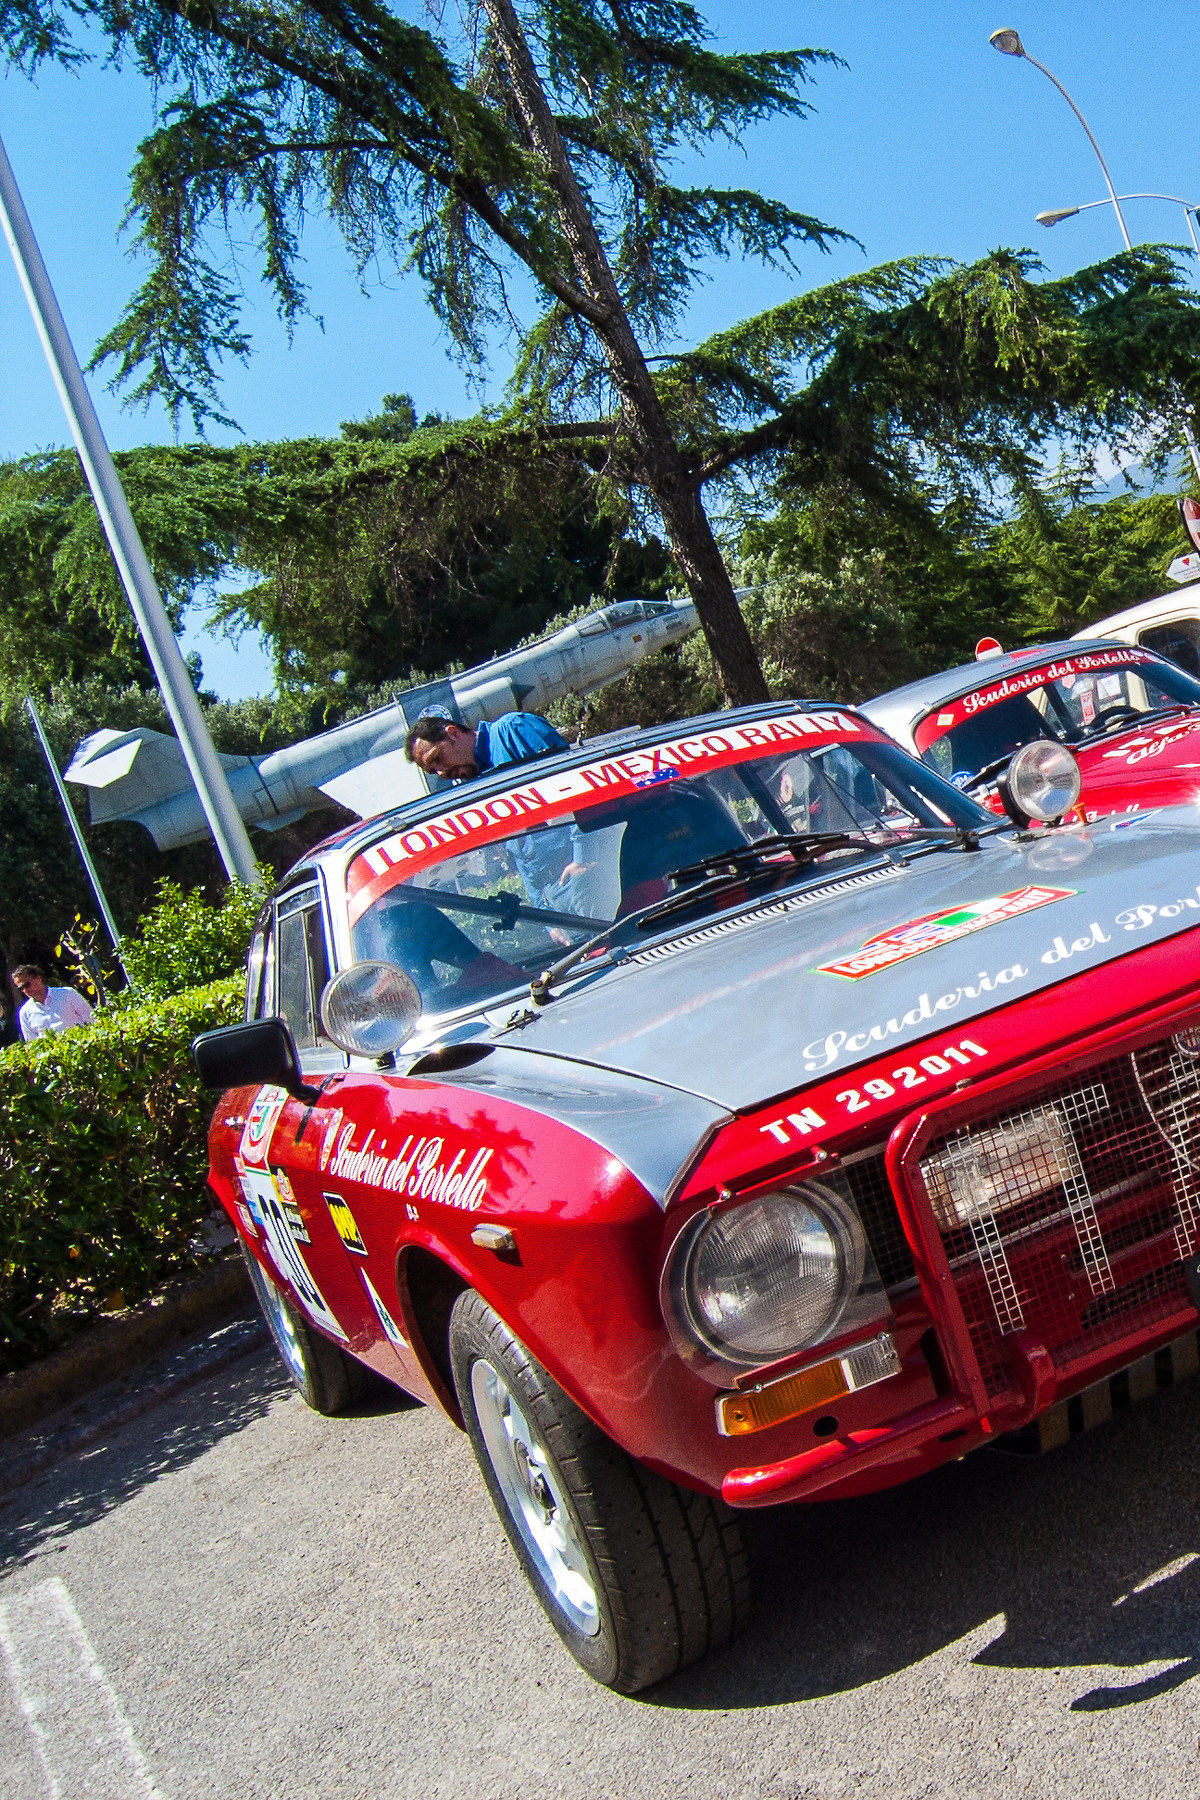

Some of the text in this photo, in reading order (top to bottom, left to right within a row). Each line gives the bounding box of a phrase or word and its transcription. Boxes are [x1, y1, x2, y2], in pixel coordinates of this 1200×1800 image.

[962, 673, 1046, 713] Scuderia
[1047, 660, 1075, 682] del
[376, 786, 550, 868] LONDON
[579, 735, 735, 791] MEXICO
[735, 715, 846, 749] RALLY
[802, 963, 1029, 1072] Scuderia
[1040, 922, 1111, 964] del
[759, 1040, 988, 1144] TN 292011
[330, 1113, 388, 1187] Scuderia
[383, 1134, 425, 1193] del
[408, 1136, 494, 1211] Portello
